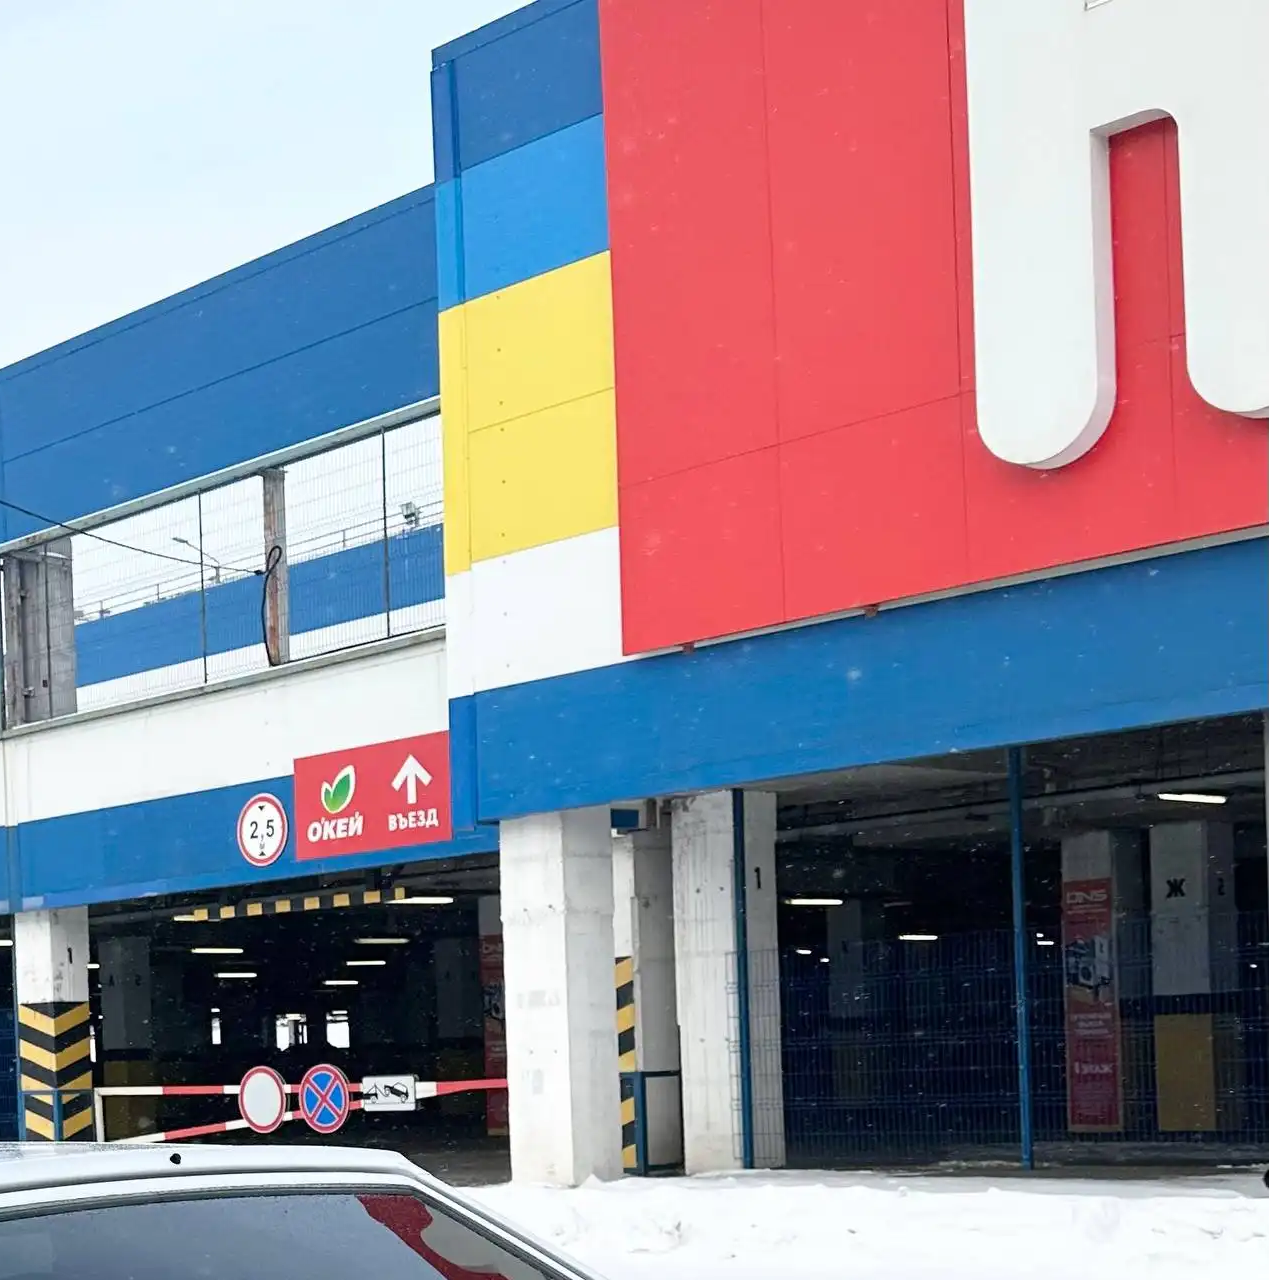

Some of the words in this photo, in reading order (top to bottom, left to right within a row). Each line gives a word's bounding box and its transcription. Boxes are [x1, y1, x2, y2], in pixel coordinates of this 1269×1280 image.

[249, 818, 275, 842] 2,5
[388, 808, 439, 832] ВЪЕЗД
[754, 867, 761, 889] 1
[1166, 878, 1186, 898] Ж
